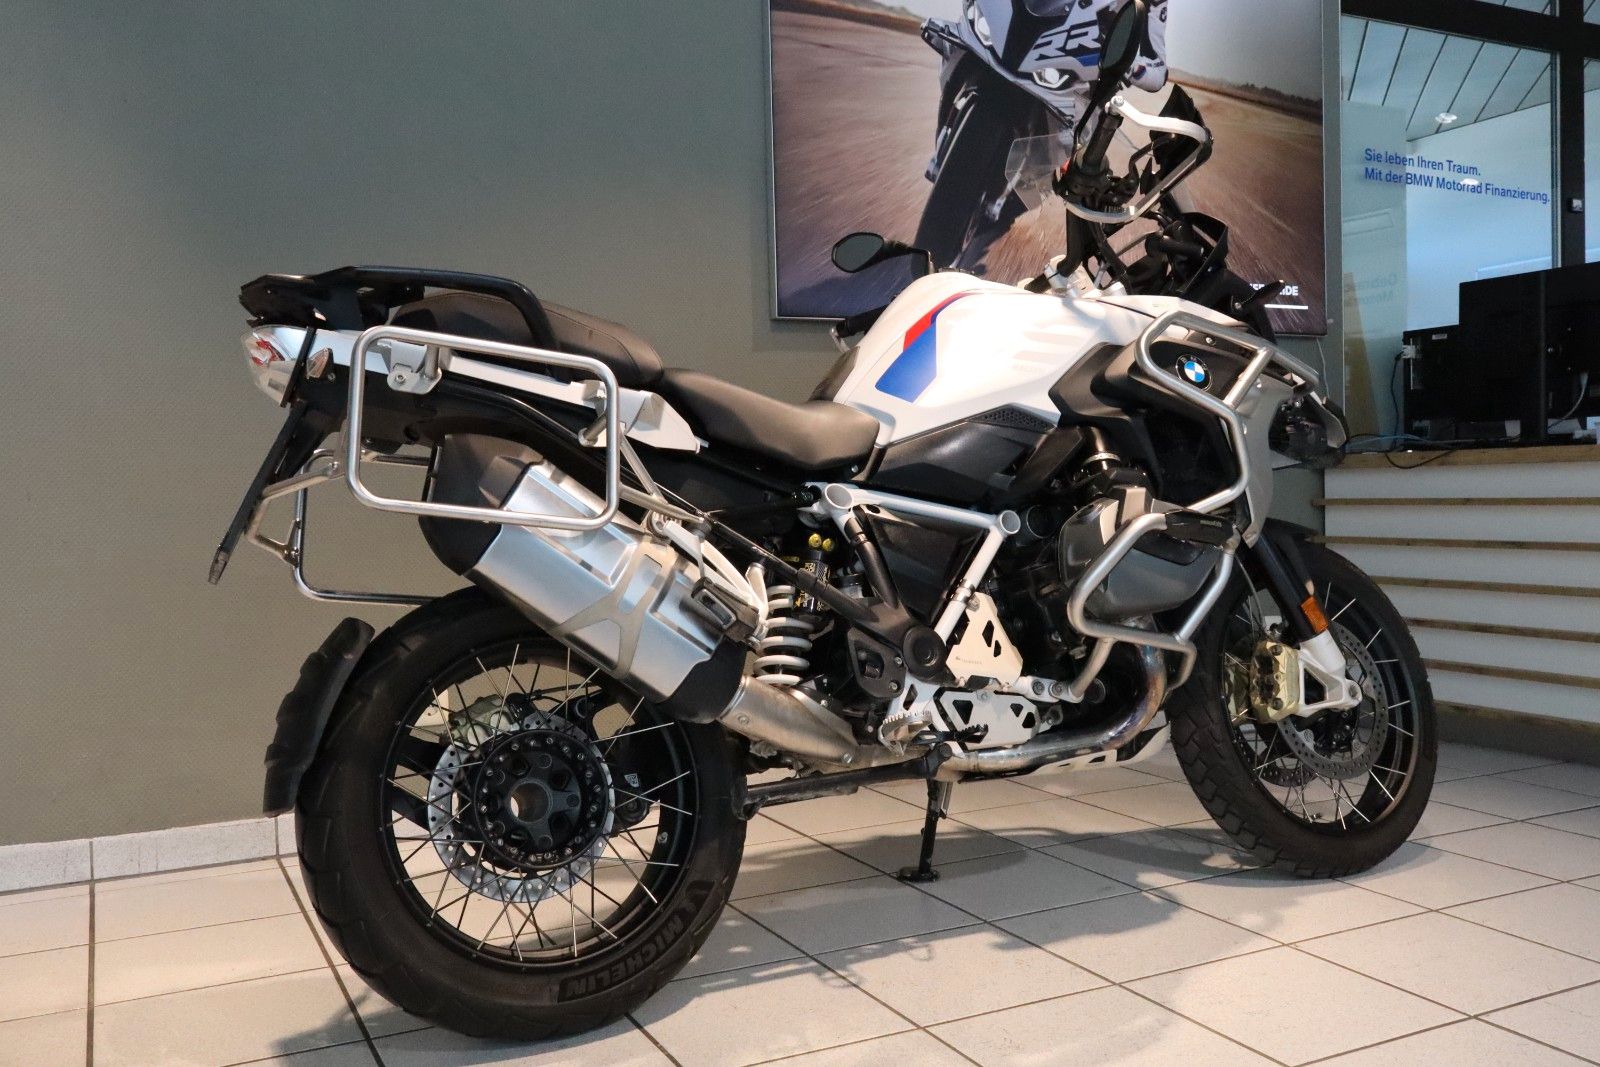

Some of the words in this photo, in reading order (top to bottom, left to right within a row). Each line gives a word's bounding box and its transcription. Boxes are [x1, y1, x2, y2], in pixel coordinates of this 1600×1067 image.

[1364, 148, 1383, 163] Sie
[1385, 151, 1415, 167] leben
[1417, 155, 1444, 171] Ihren
[1446, 159, 1481, 176] Traum.
[1364, 167, 1383, 181] Mit
[1385, 170, 1403, 184] der
[1405, 172, 1434, 188] BMW
[1436, 176, 1483, 194] Motorrad
[1485, 183, 1550, 204] Finanzierung.
[567, 914, 684, 996] MICHELIN
